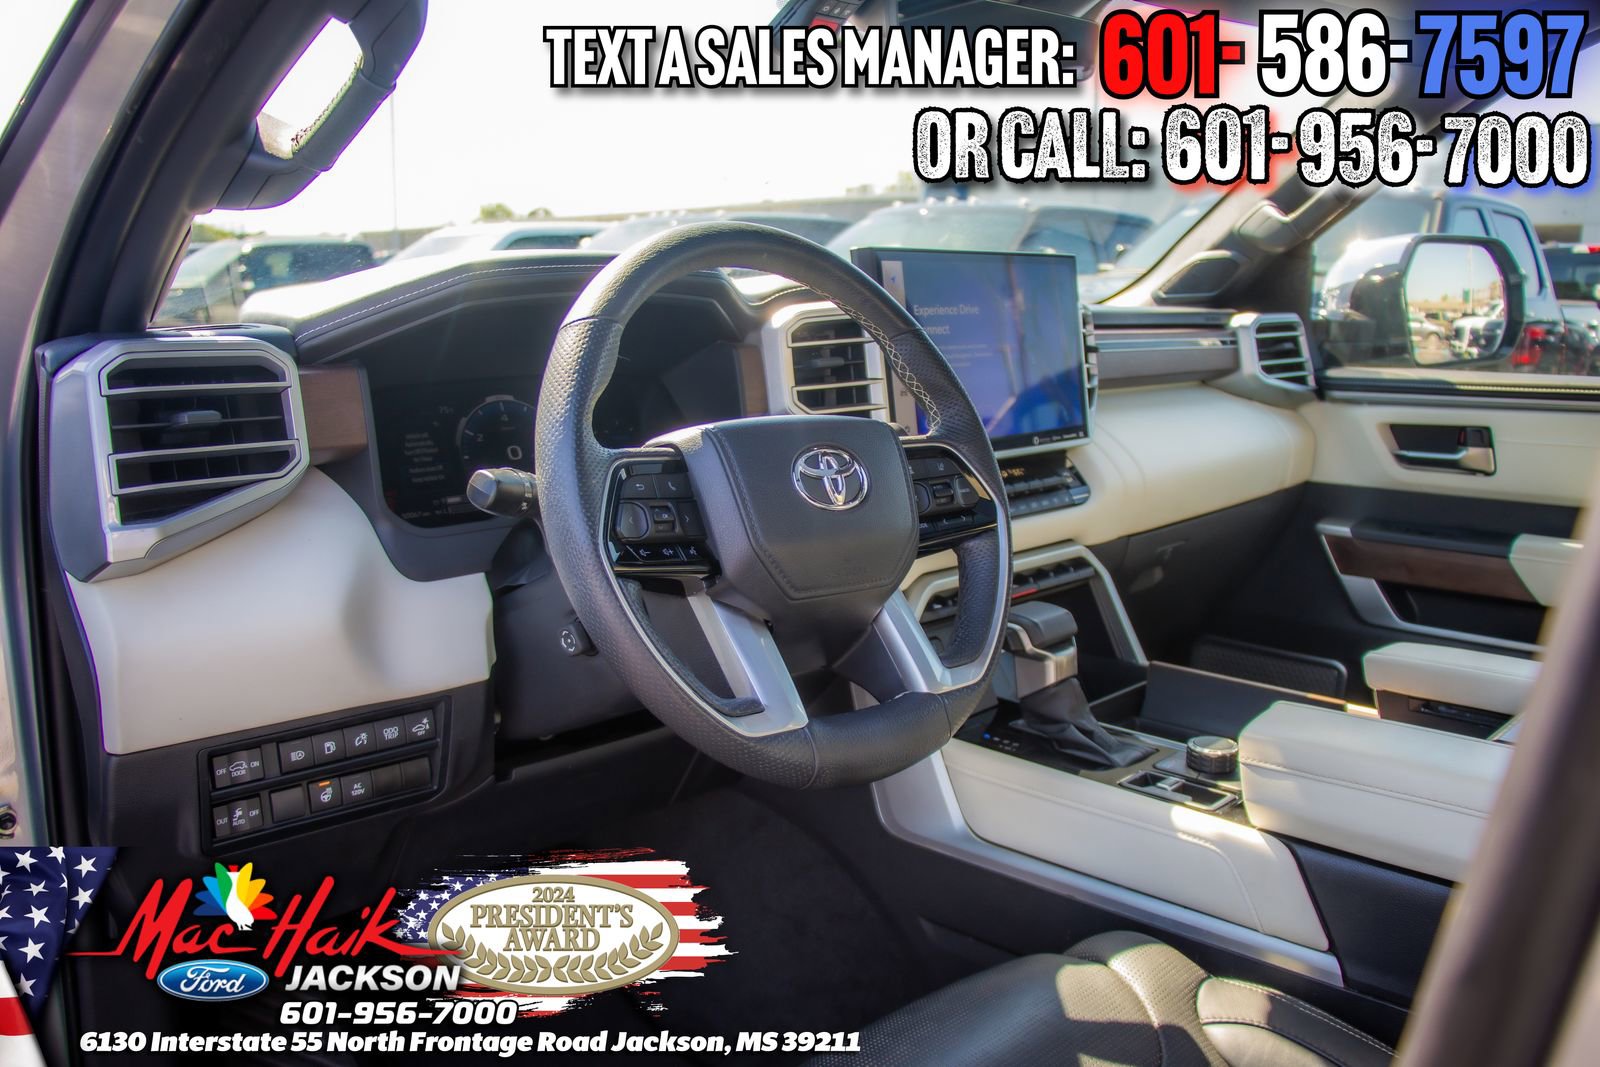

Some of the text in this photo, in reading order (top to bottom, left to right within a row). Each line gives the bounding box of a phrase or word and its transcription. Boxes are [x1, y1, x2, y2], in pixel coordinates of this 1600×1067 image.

[914, 303, 980, 317] Experience Drive
[923, 325, 951, 335] nnect
[506, 445, 523, 461] 0
[383, 726, 399, 736] ODO
[384, 732, 399, 740] TRIP
[250, 761, 260, 769] ON
[216, 767, 227, 776] OFF
[231, 769, 246, 778] DOOR
[353, 782, 363, 790] AC
[249, 809, 260, 817] OFF
[216, 816, 229, 826] OUT
[232, 818, 246, 827] AUTO
